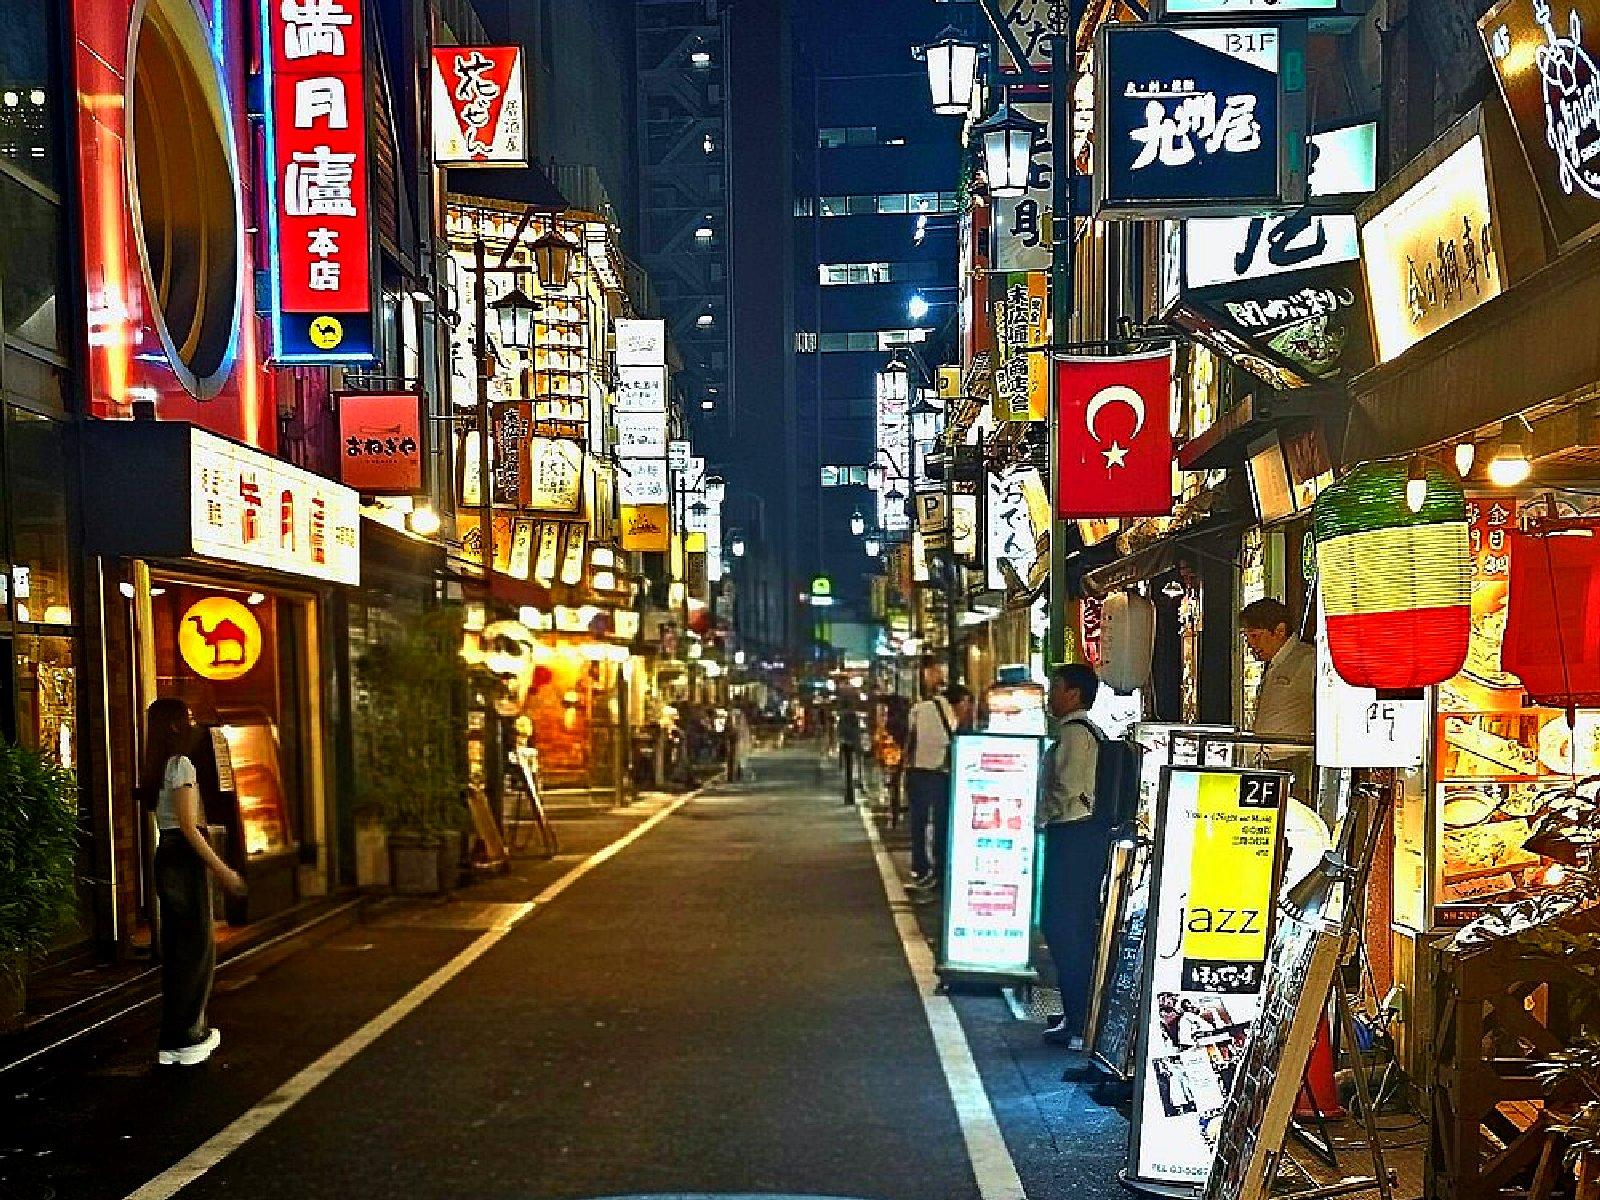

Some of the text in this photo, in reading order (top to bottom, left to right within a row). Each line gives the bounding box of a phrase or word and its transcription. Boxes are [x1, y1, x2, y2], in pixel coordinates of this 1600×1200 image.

[1226, 33, 1276, 53] B1F
[308, 228, 341, 292] 本店
[1246, 781, 1275, 805] 2F
[1159, 892, 1261, 960] jazz
